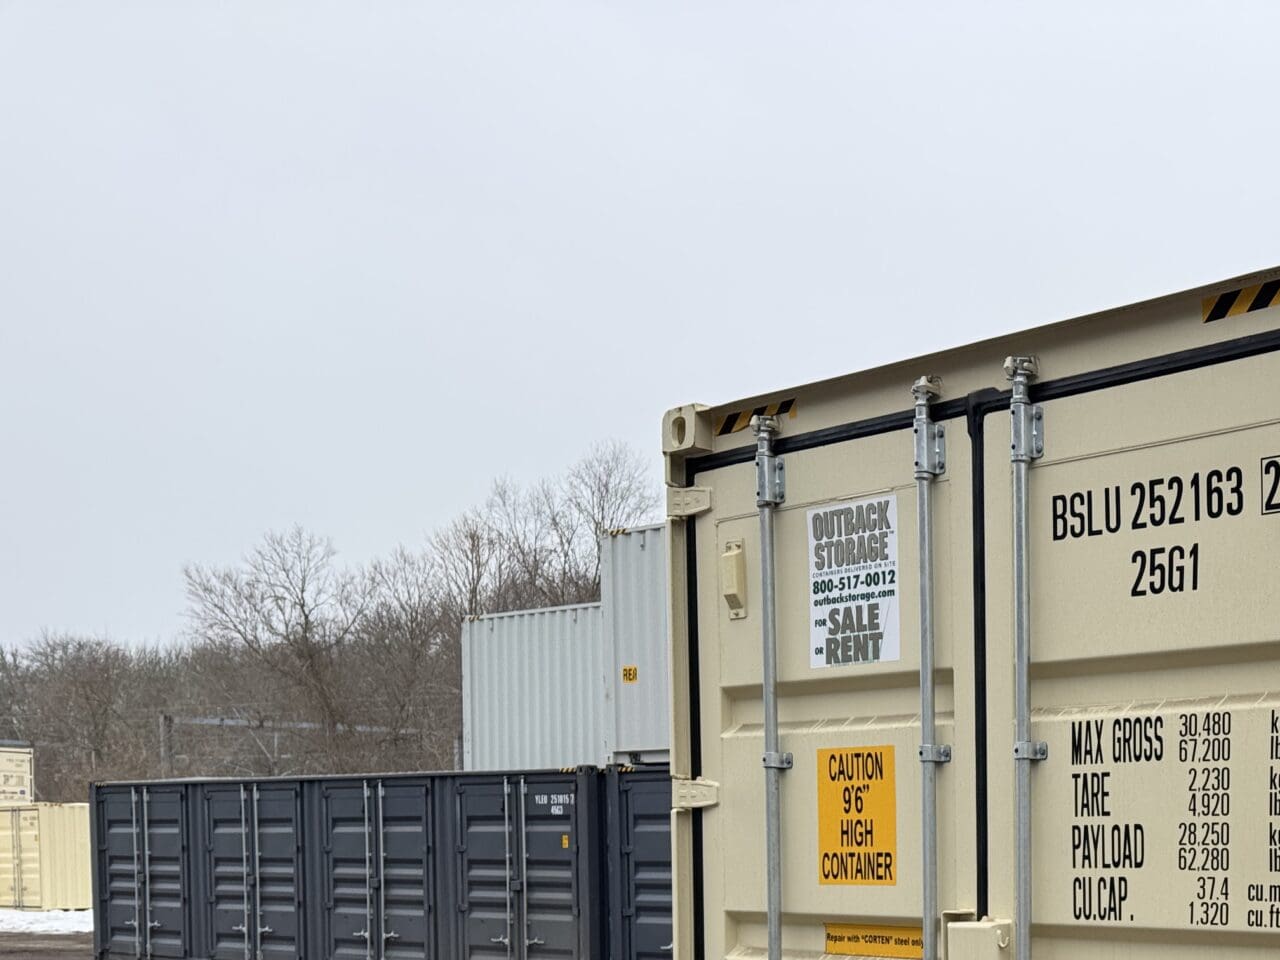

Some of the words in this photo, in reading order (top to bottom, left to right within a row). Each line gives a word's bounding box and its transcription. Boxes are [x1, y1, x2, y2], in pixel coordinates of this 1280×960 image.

[1052, 486, 1121, 541] BSLU
[1130, 466, 1243, 530] 252163
[812, 500, 891, 541] OUTBACK
[814, 531, 889, 570] STORAGE
[812, 569, 896, 595] 800-517-0012
[844, 564, 872, 574] DELIVERED
[1131, 543, 1199, 597] 25G1
[813, 588, 895, 607] outbackstorage.com
[814, 618, 827, 628] FOR
[828, 603, 880, 636] SALE
[815, 647, 824, 655] OR
[825, 632, 883, 665] RENT
[1071, 719, 1104, 766] MAX
[1112, 716, 1163, 763] GROSS
[1179, 712, 1231, 737] 30,480
[1179, 737, 1231, 763] 67,200
[828, 752, 883, 781] CAUTION
[1072, 772, 1111, 817] TARE
[1188, 767, 1230, 792] 2,230
[1188, 793, 1230, 818] 4,920
[840, 819, 873, 847] HIGH
[1072, 824, 1144, 869] PAYLOAD
[1178, 822, 1230, 847] 28,250
[822, 852, 893, 881] CONTAINER
[1178, 848, 1230, 871] 62,280
[1196, 876, 1229, 900] 37.4
[1189, 901, 1229, 926] 1,320
[826, 932, 846, 944] Repair
[846, 934, 860, 943] with
[861, 934, 893, 945] "CORTEN"
[894, 936, 910, 946] steel
[911, 937, 923, 949] only
